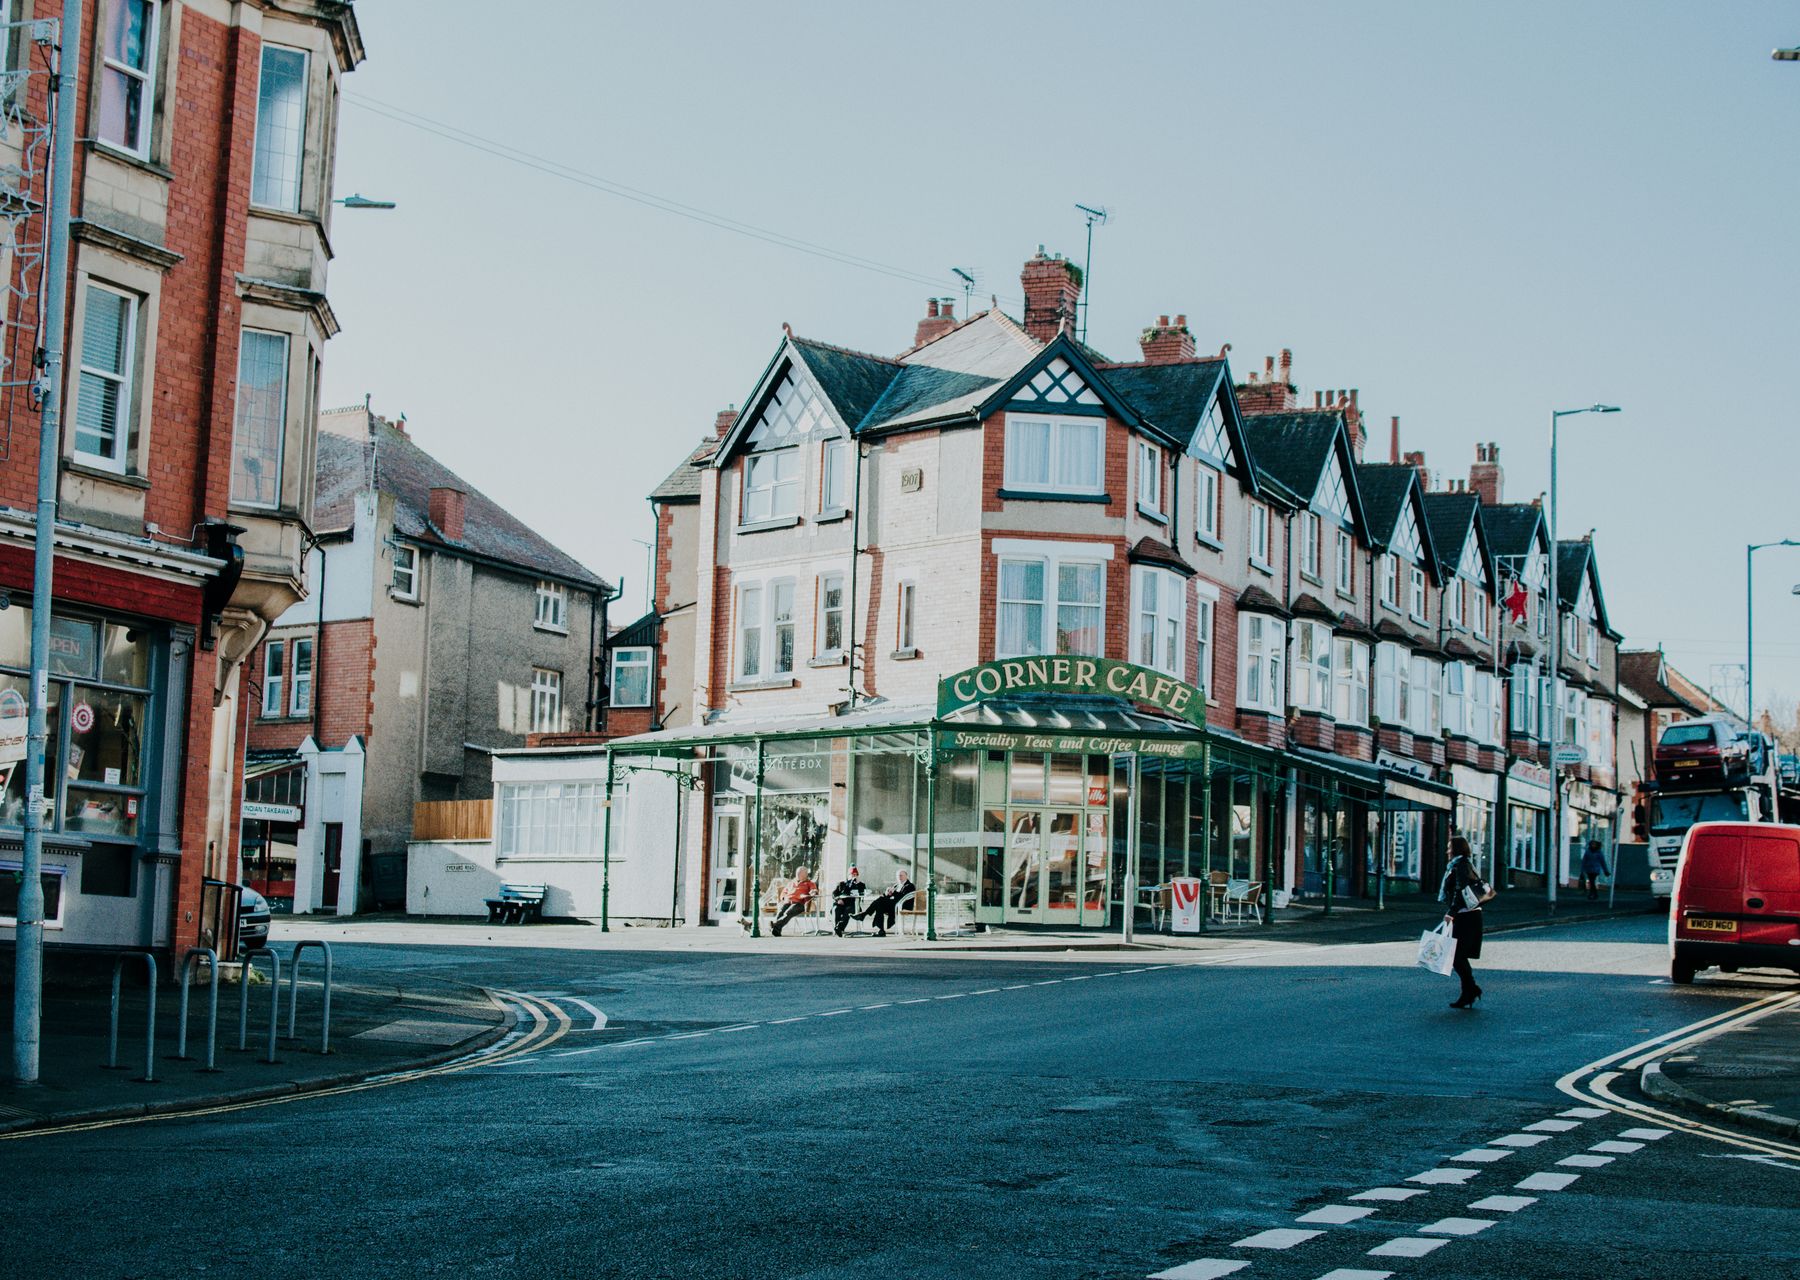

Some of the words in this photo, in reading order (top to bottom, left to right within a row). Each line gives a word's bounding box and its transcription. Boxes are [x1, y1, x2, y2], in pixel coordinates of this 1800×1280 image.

[953, 659, 1096, 702] CORNER
[1106, 666, 1192, 713] CAFÉ
[955, 732, 1018, 748] Speciality
[1024, 735, 1053, 749] Teas
[1059, 738, 1083, 750] and
[1089, 737, 1132, 751] Coffee
[1138, 740, 1185, 755] Lounge
[800, 759, 822, 770] BOX
[1089, 788, 1106, 802] illy
[243, 805, 263, 813] INDIAN
[264, 806, 294, 815] TAKEAWAY
